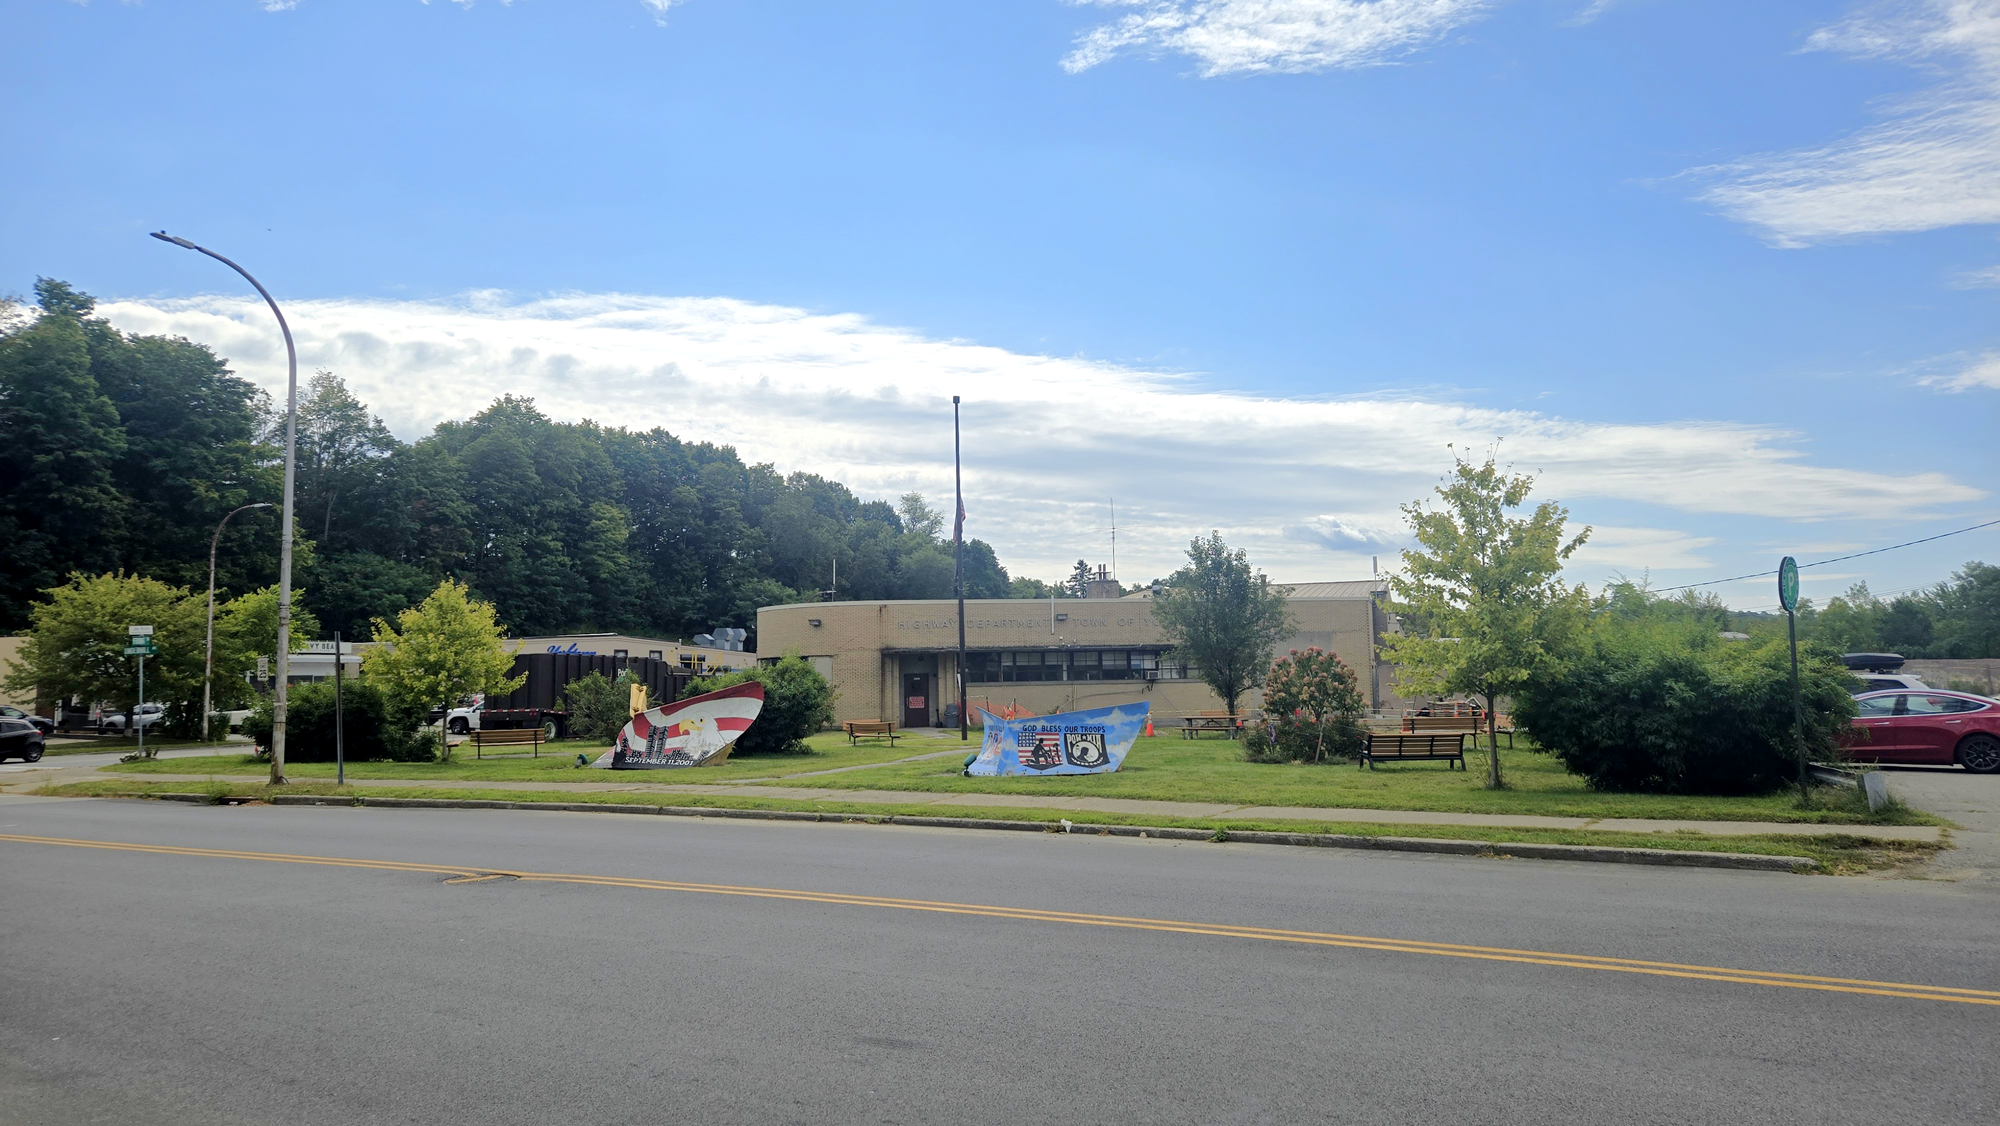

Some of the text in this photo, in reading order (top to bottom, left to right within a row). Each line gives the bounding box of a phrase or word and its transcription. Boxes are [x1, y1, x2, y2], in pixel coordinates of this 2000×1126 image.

[897, 619, 956, 630] HIGHWAY
[966, 618, 1050, 629] DEPARTMENT
[1073, 617, 1107, 627] TOWN
[1117, 617, 1134, 627] OF
[1022, 724, 1106, 733] GOD BLESS OUR TROOPS
[1066, 734, 1081, 753] POW
[625, 756, 667, 765] SEPTEMBER
